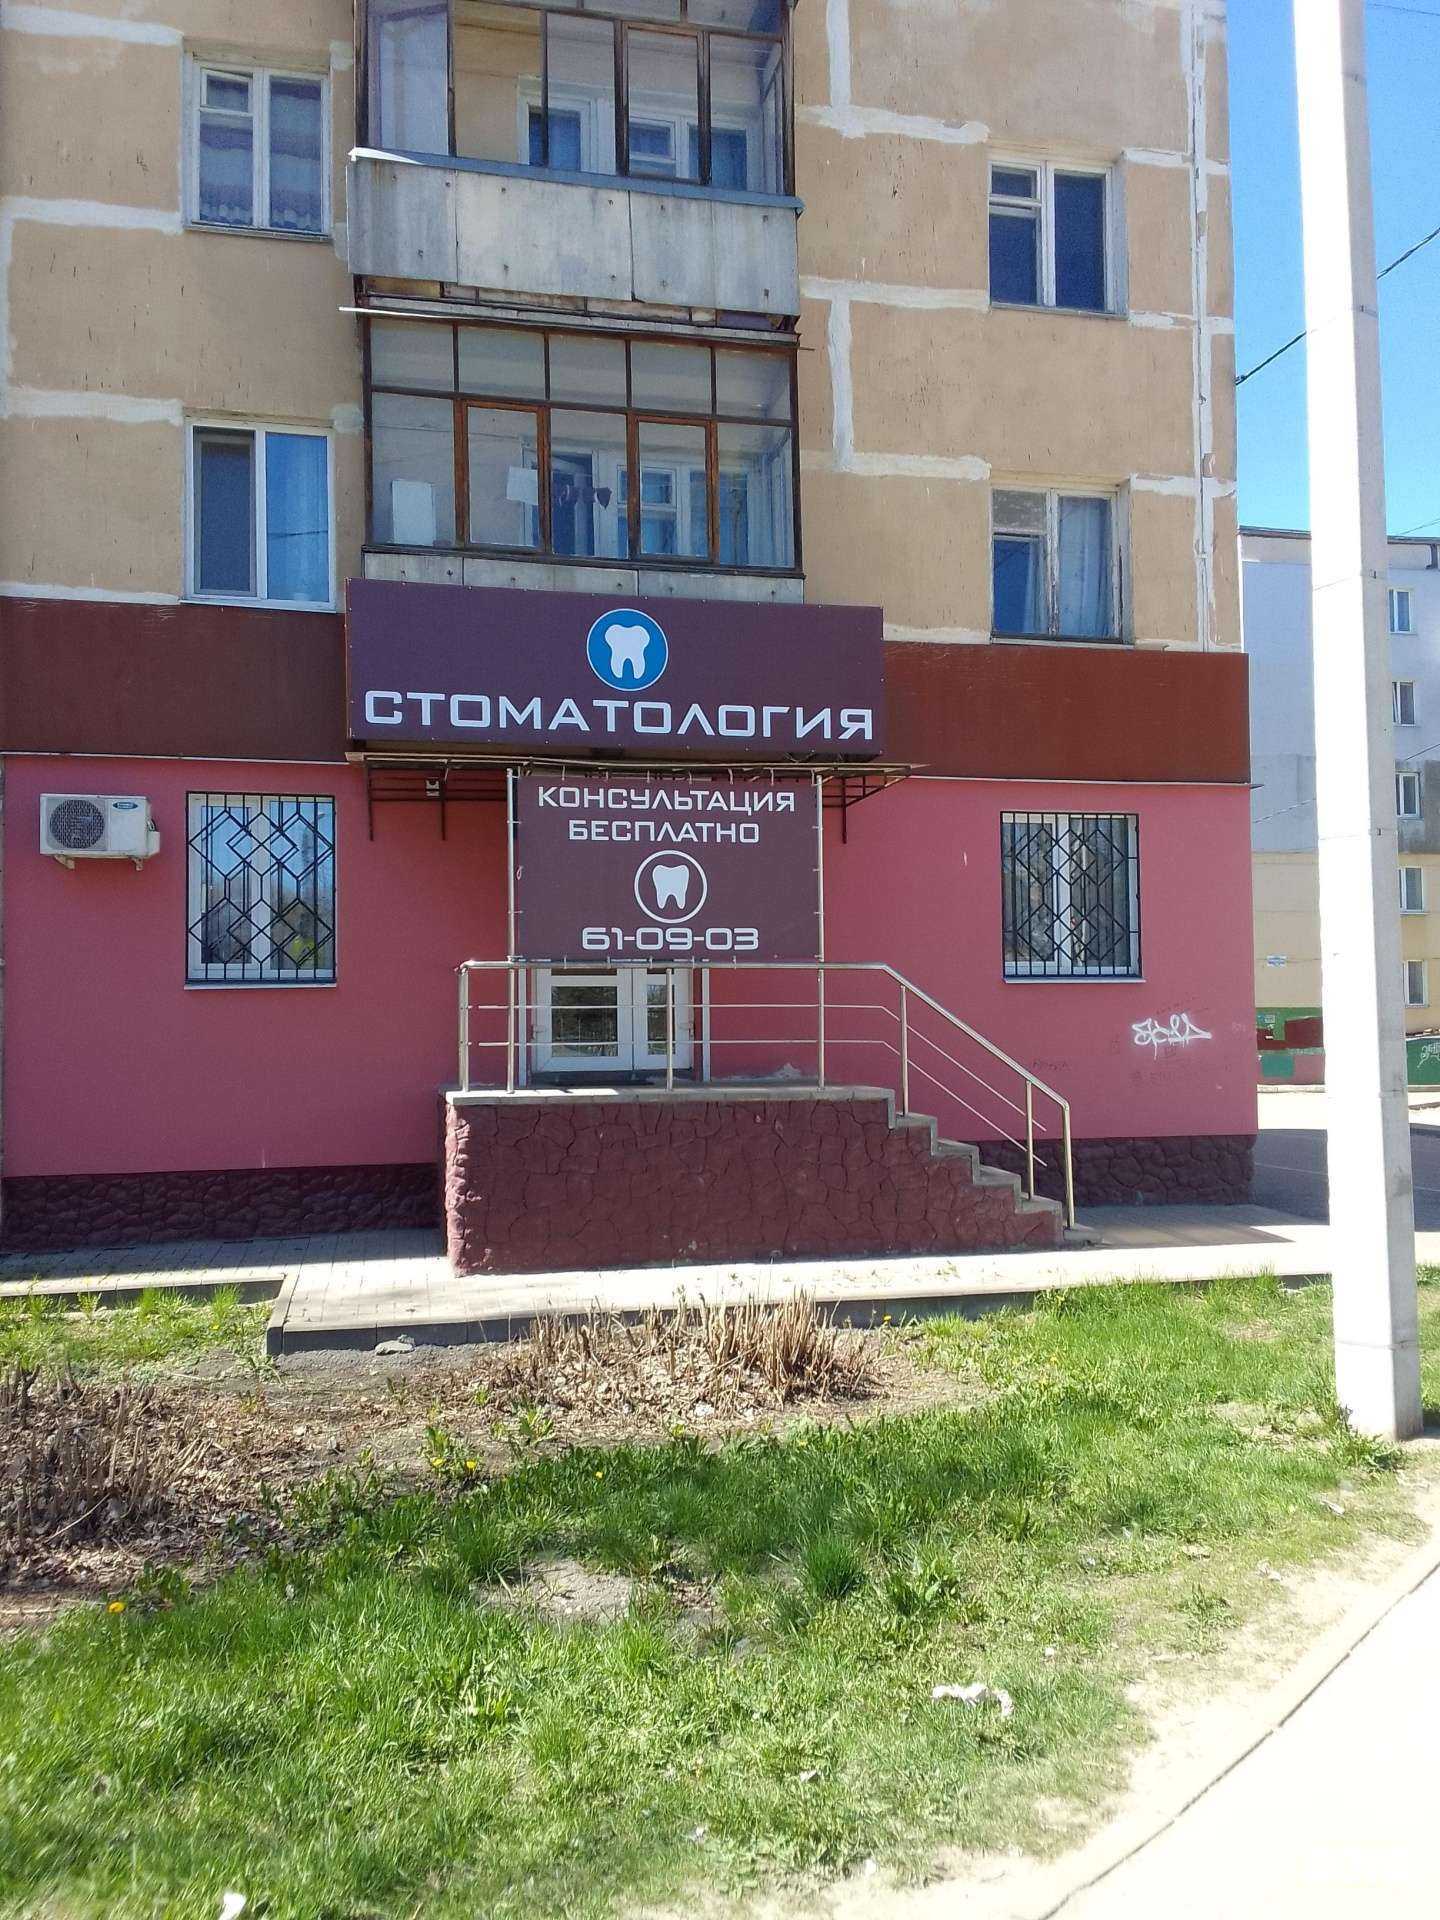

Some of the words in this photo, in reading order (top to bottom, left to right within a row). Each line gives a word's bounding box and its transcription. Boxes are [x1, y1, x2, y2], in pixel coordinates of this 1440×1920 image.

[365, 690, 873, 740] СТОМАТОЛОГИЯ
[537, 786, 795, 813] КОНСУЛЬТАЦИЯ
[568, 819, 760, 843] БЕСПЛАТНО
[581, 927, 760, 950] 61-09-03
